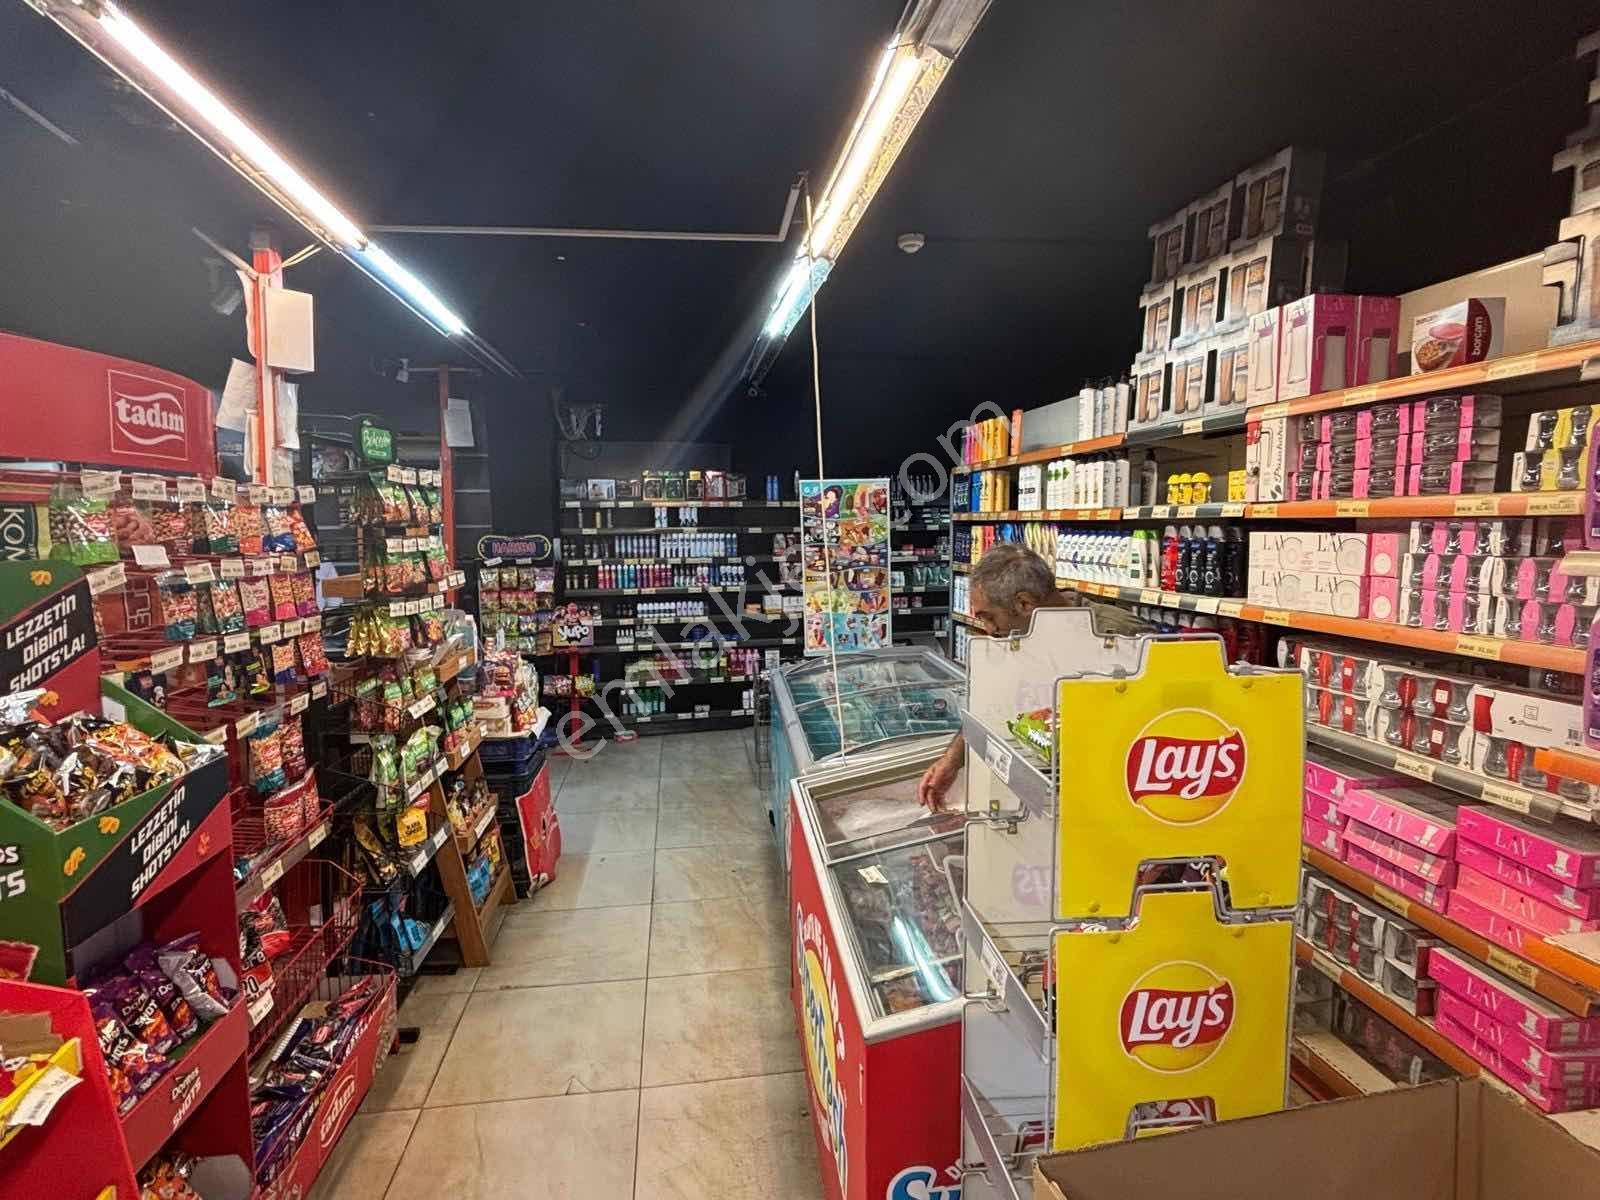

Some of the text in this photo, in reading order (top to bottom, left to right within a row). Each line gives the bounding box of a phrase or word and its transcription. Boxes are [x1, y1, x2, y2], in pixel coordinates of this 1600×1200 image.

[114, 398, 185, 434] tadım
[1134, 736, 1239, 800] Lay's
[1127, 986, 1229, 1048] Lay's
